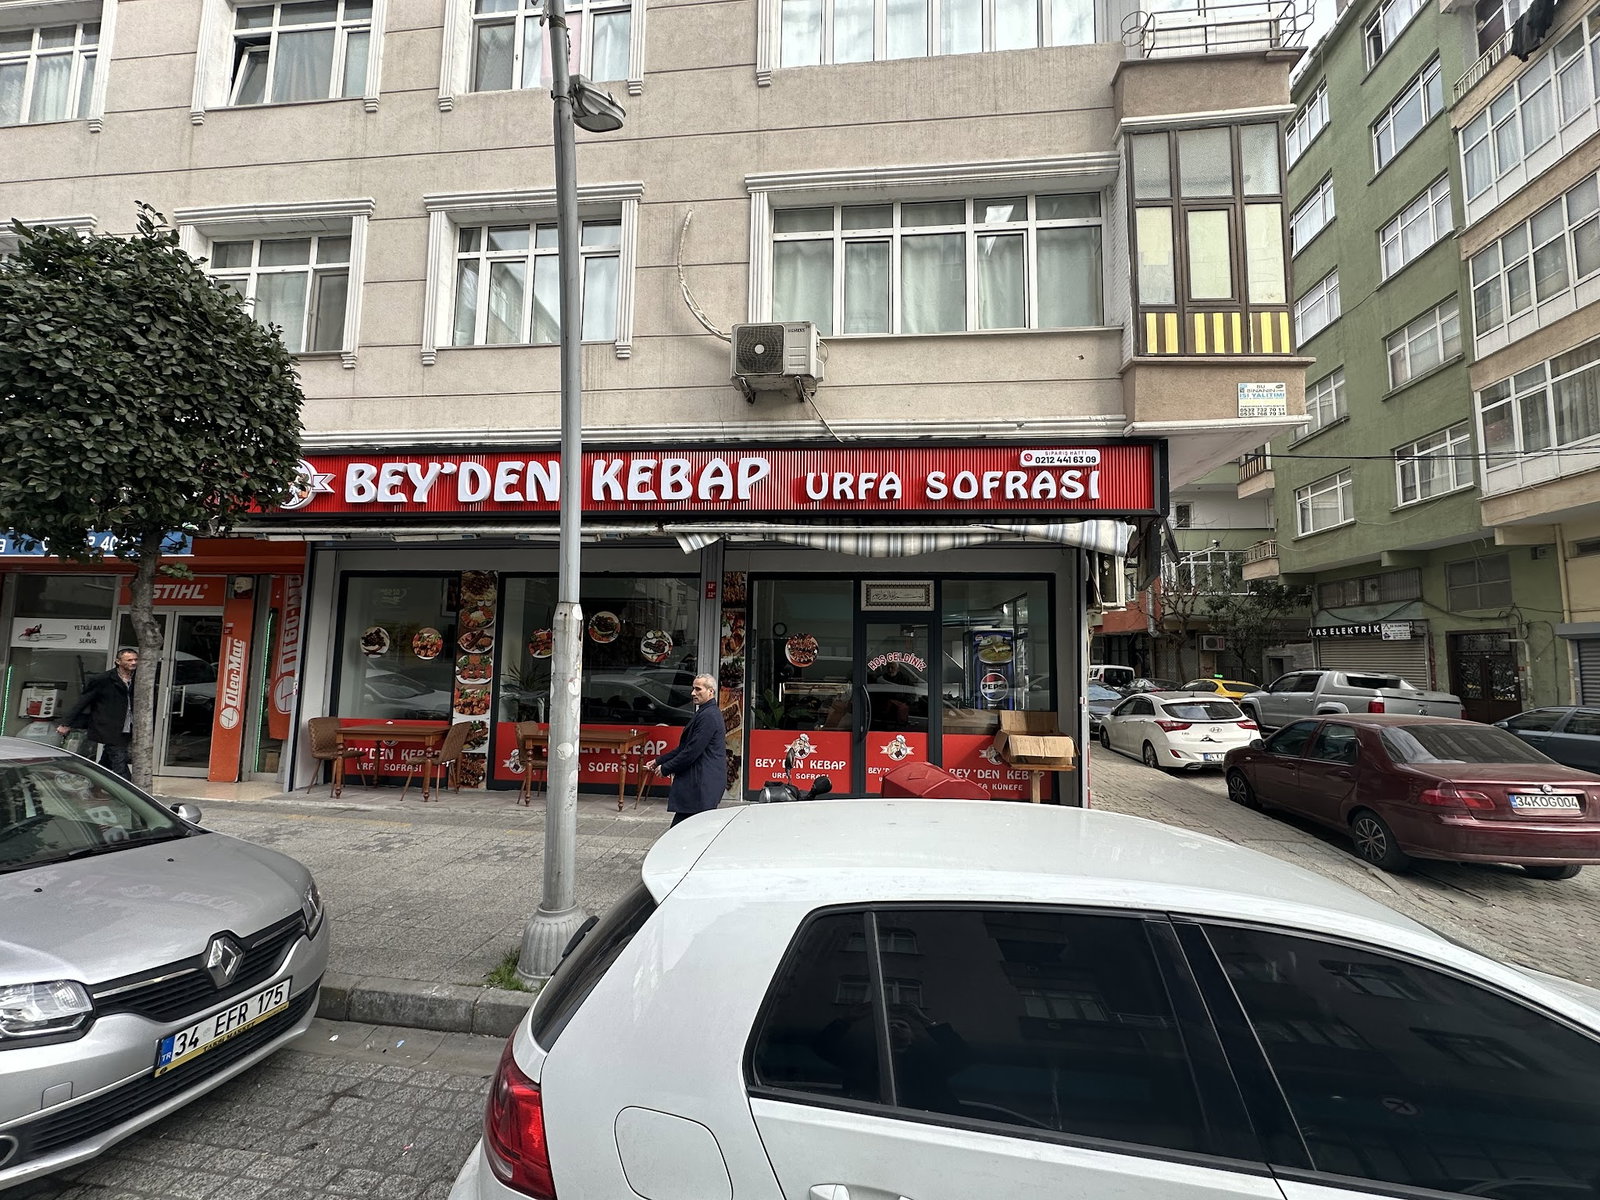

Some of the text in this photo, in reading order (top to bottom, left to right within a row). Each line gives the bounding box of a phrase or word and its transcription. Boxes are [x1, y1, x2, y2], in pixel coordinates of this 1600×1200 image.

[345, 457, 770, 504] BEY'DEN KEBAP
[805, 470, 1100, 500] URFA SOFRASI
[152, 584, 204, 599] STIHL
[1316, 628, 1328, 636] AS
[1330, 624, 1380, 636] ELEKTRİK
[868, 652, 927, 672] HOŞ GELDİNİZ
[810, 760, 846, 770] KEBAP
[1516, 796, 1578, 808] 34KOG004
[174, 1026, 199, 1056] 34
[214, 1002, 248, 1038] EFR
[258, 984, 284, 1014] 175
[162, 1052, 171, 1062] TR
